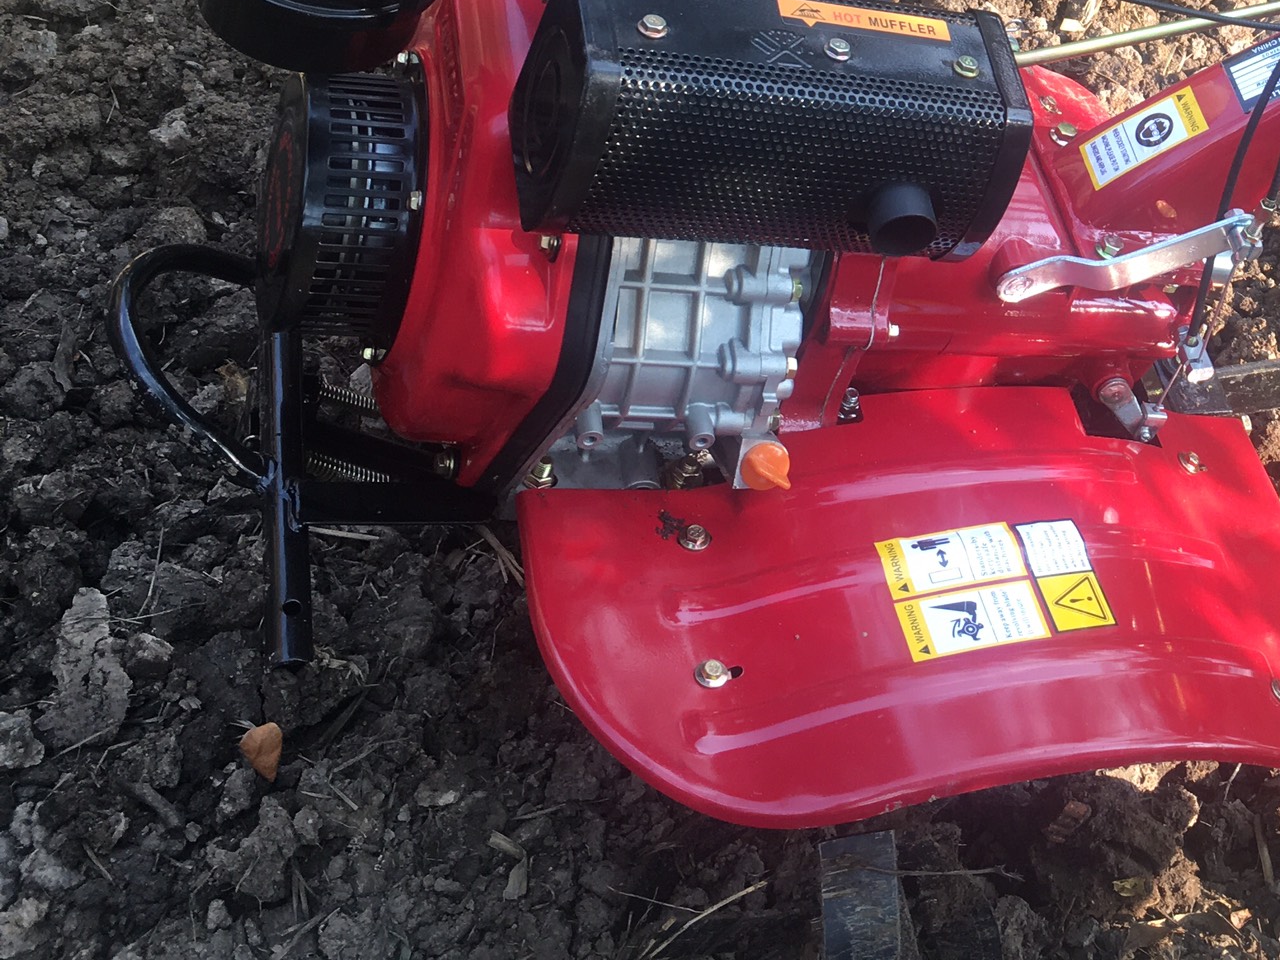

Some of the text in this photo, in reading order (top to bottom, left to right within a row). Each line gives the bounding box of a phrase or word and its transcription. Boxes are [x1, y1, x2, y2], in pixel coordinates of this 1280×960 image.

[833, 11, 937, 36] HOT MUFFLER
[1251, 40, 1276, 53] CHINA
[1181, 101, 1200, 132] WARNING
[885, 543, 904, 582] WARNING
[904, 604, 924, 643] WARNING
[991, 591, 1012, 638] Keep away from
